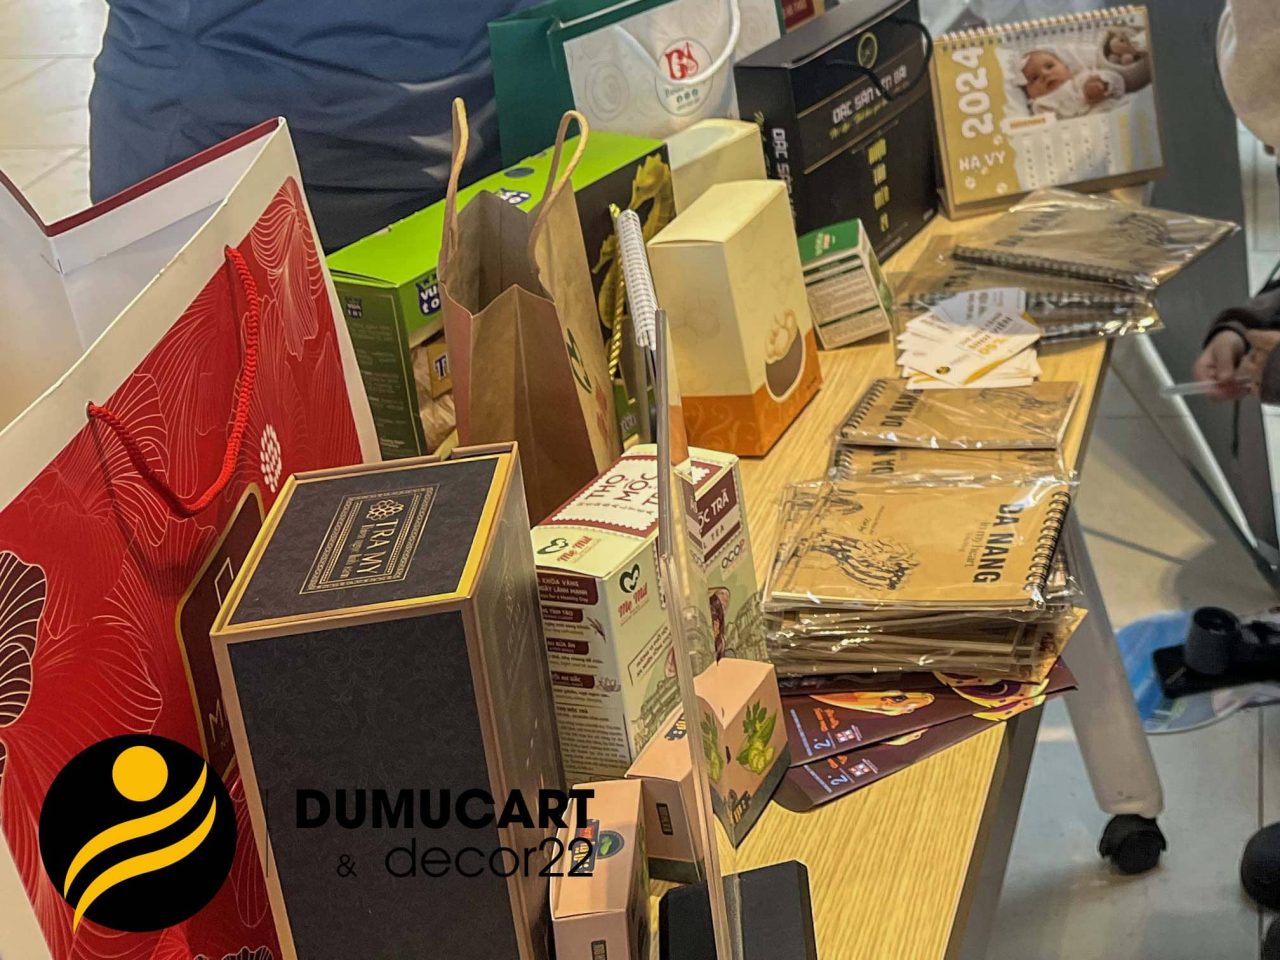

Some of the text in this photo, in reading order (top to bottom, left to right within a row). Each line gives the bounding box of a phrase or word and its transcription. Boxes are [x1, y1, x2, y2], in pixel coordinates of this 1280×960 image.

[952, 47, 994, 138] 2024
[721, 538, 745, 569] OCOP
[972, 503, 1024, 584] DA NANG
